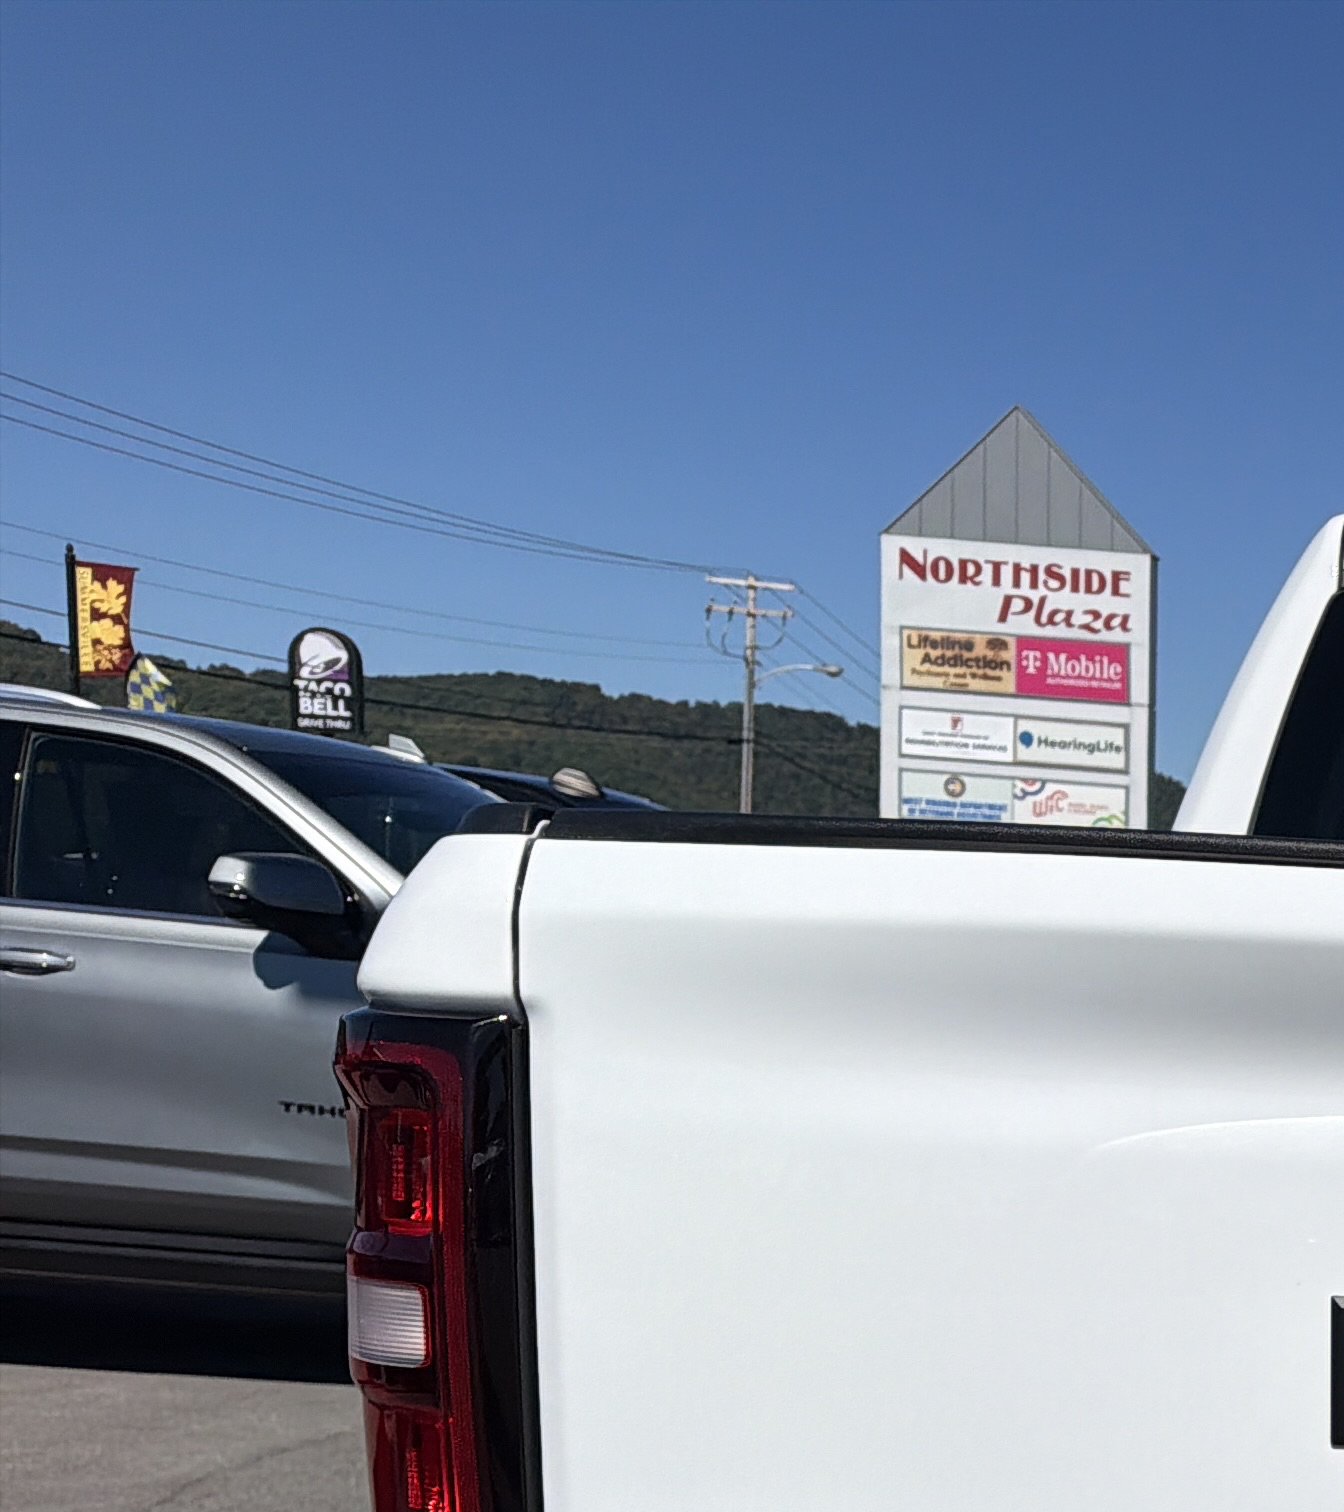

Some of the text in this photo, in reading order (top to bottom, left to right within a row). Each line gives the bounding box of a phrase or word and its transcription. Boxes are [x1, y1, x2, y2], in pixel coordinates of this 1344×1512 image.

[898, 547, 1132, 598] NORTHSIDE
[997, 594, 1132, 634] Plaza
[906, 633, 975, 653] Lifeline
[920, 652, 1012, 672] Addiction
[1046, 651, 1122, 681] Mobile
[293, 678, 352, 697] TACO
[299, 697, 353, 717] BELL
[1037, 735, 1123, 755] HearingLife
